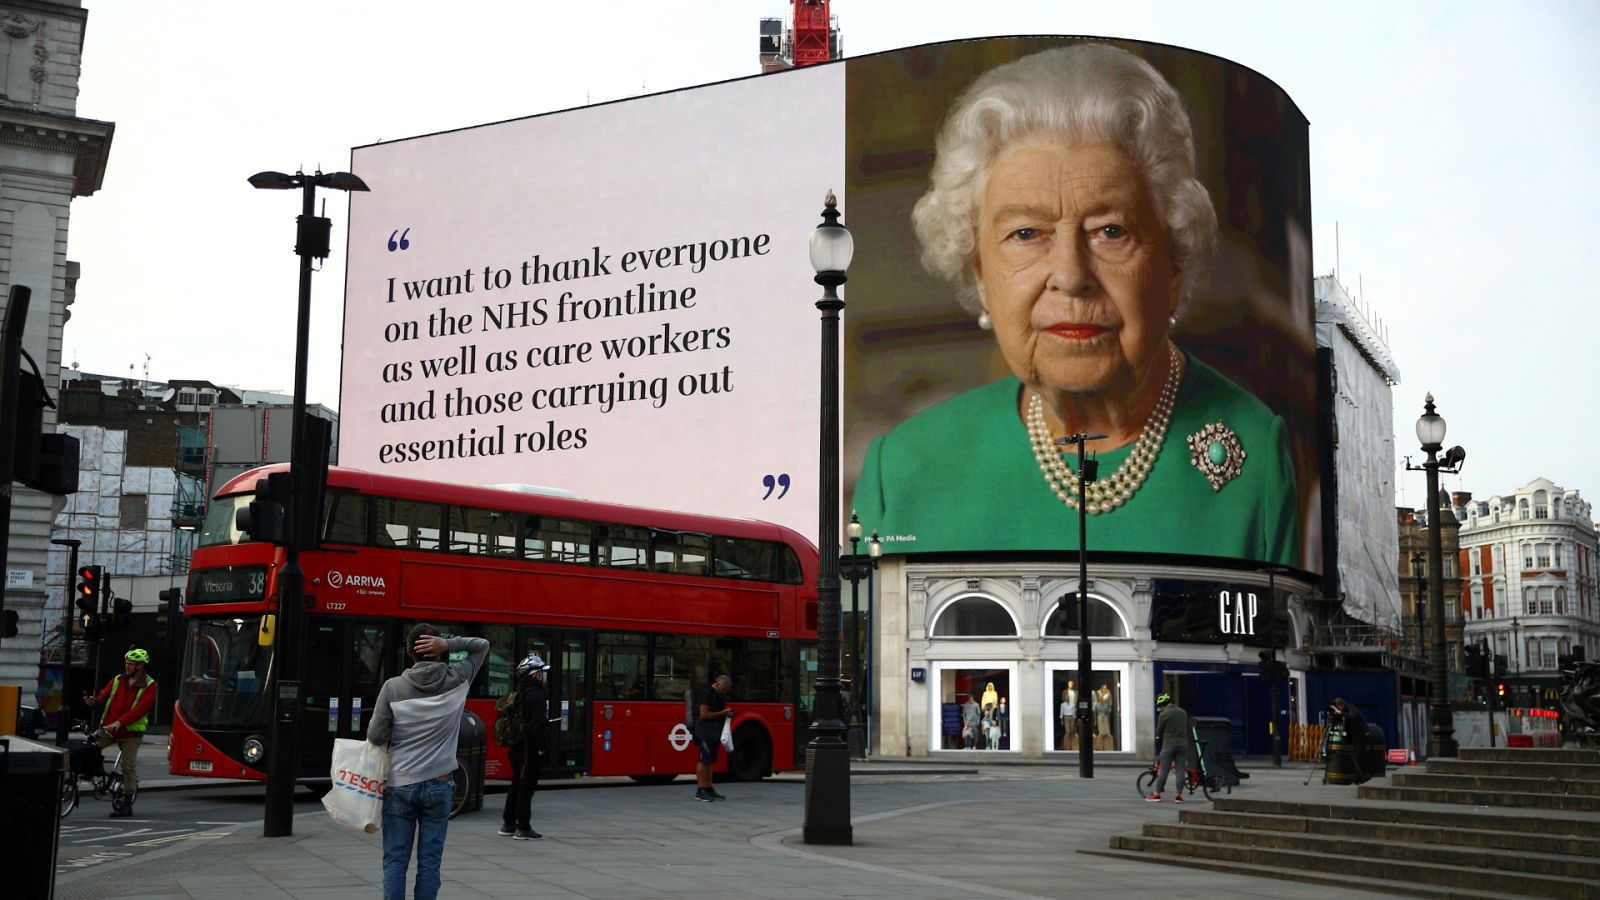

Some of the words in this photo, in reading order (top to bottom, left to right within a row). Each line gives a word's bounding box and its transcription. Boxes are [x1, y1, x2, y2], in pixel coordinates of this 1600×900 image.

[388, 278, 396, 302] I
[403, 269, 474, 300] want
[484, 267, 511, 290] to
[521, 247, 612, 285] thank
[621, 233, 770, 273] everyone
[385, 321, 419, 342] on
[427, 308, 473, 337] the
[482, 298, 548, 331] NHS
[558, 283, 697, 324] frontline
[383, 362, 413, 382] as
[420, 345, 476, 378] well
[486, 351, 518, 372] as
[527, 342, 592, 367] care
[601, 323, 731, 359] workers
[381, 390, 436, 423] and
[445, 388, 523, 417] those
[532, 372, 668, 413] carrying
[678, 365, 733, 397] out
[380, 425, 505, 463] essential
[515, 421, 588, 454] roles
[895, 534, 916, 542] Media
[204, 579, 233, 592] Victoria
[248, 572, 265, 594] 38
[345, 574, 386, 588] ARRIVA
[326, 601, 346, 610] LT227
[1220, 590, 1257, 635] GAP
